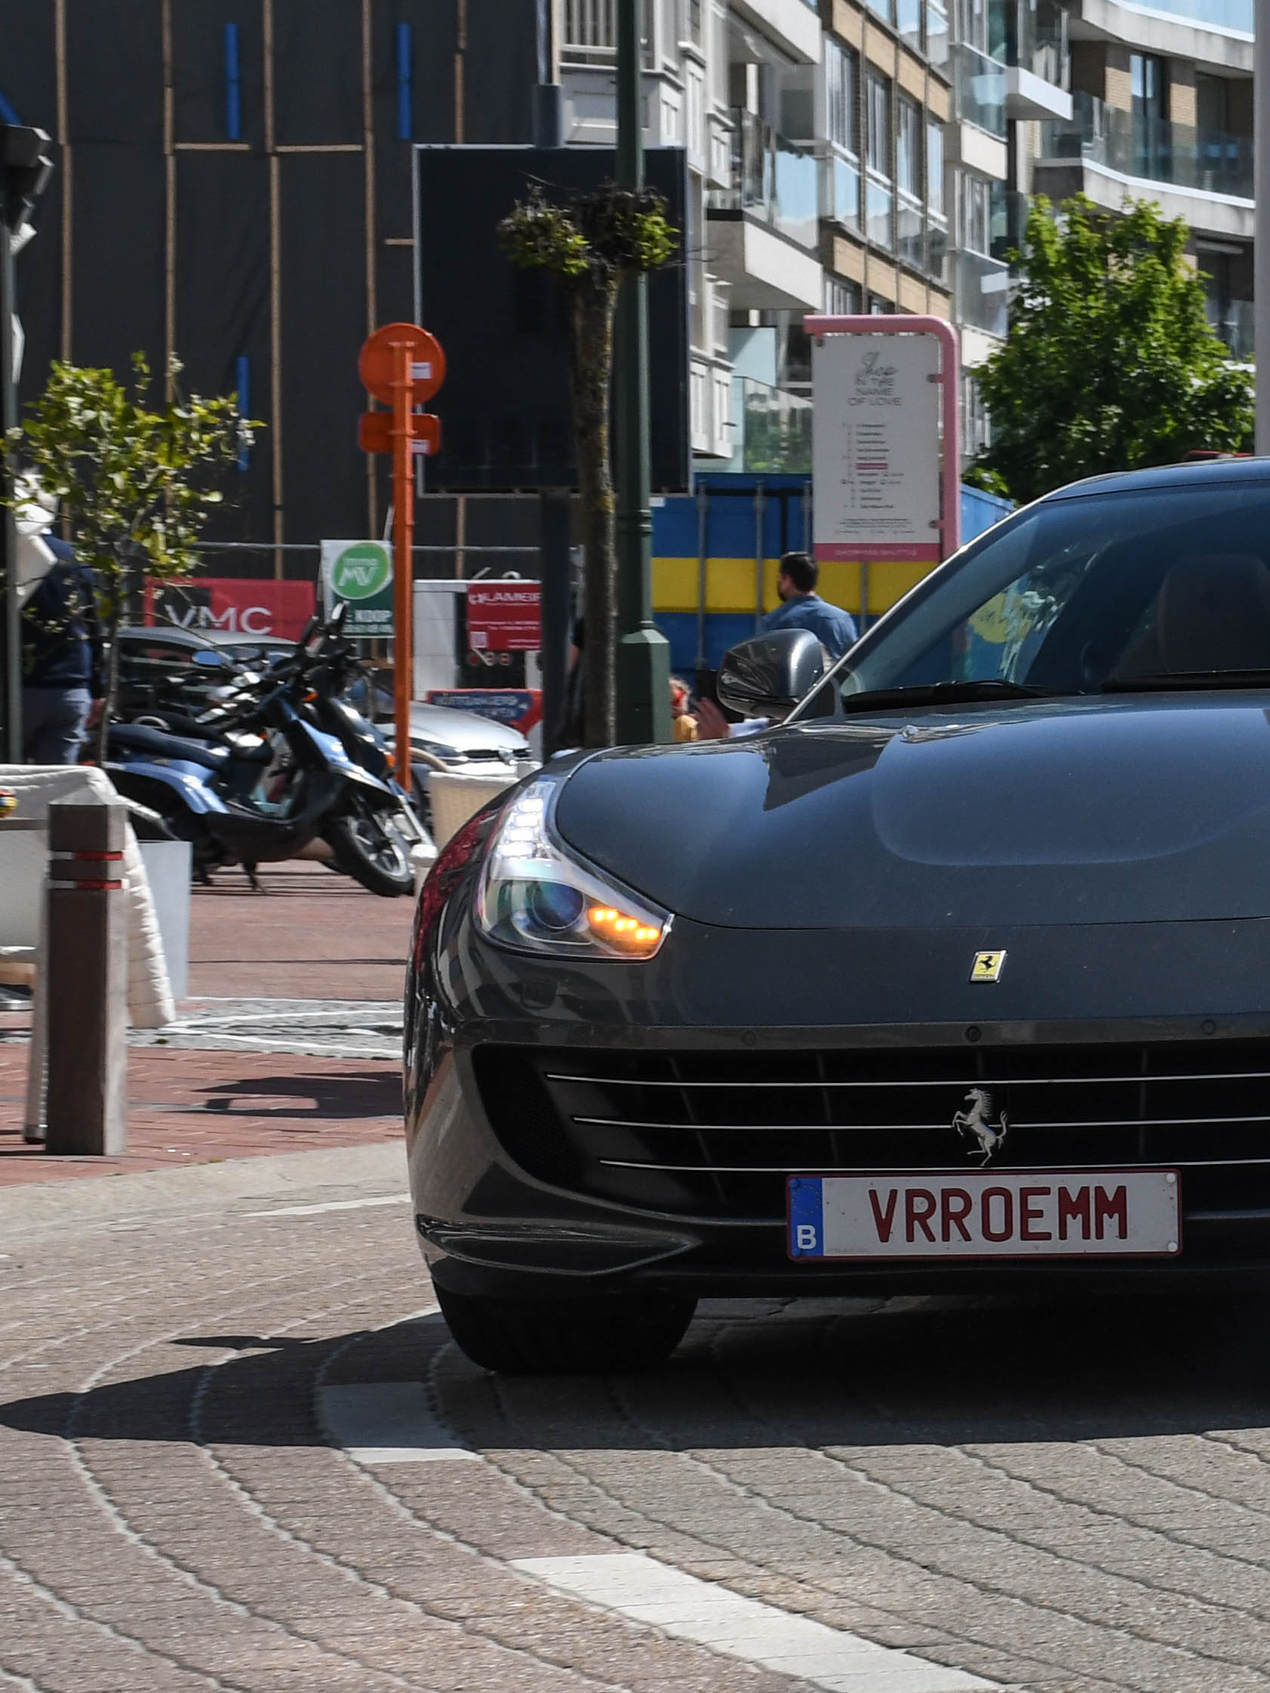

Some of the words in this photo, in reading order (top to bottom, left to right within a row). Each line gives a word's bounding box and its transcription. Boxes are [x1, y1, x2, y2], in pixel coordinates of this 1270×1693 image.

[164, 604, 273, 634] VMC
[868, 1185, 1128, 1243] VRROEMM
[797, 1225, 816, 1249] B
